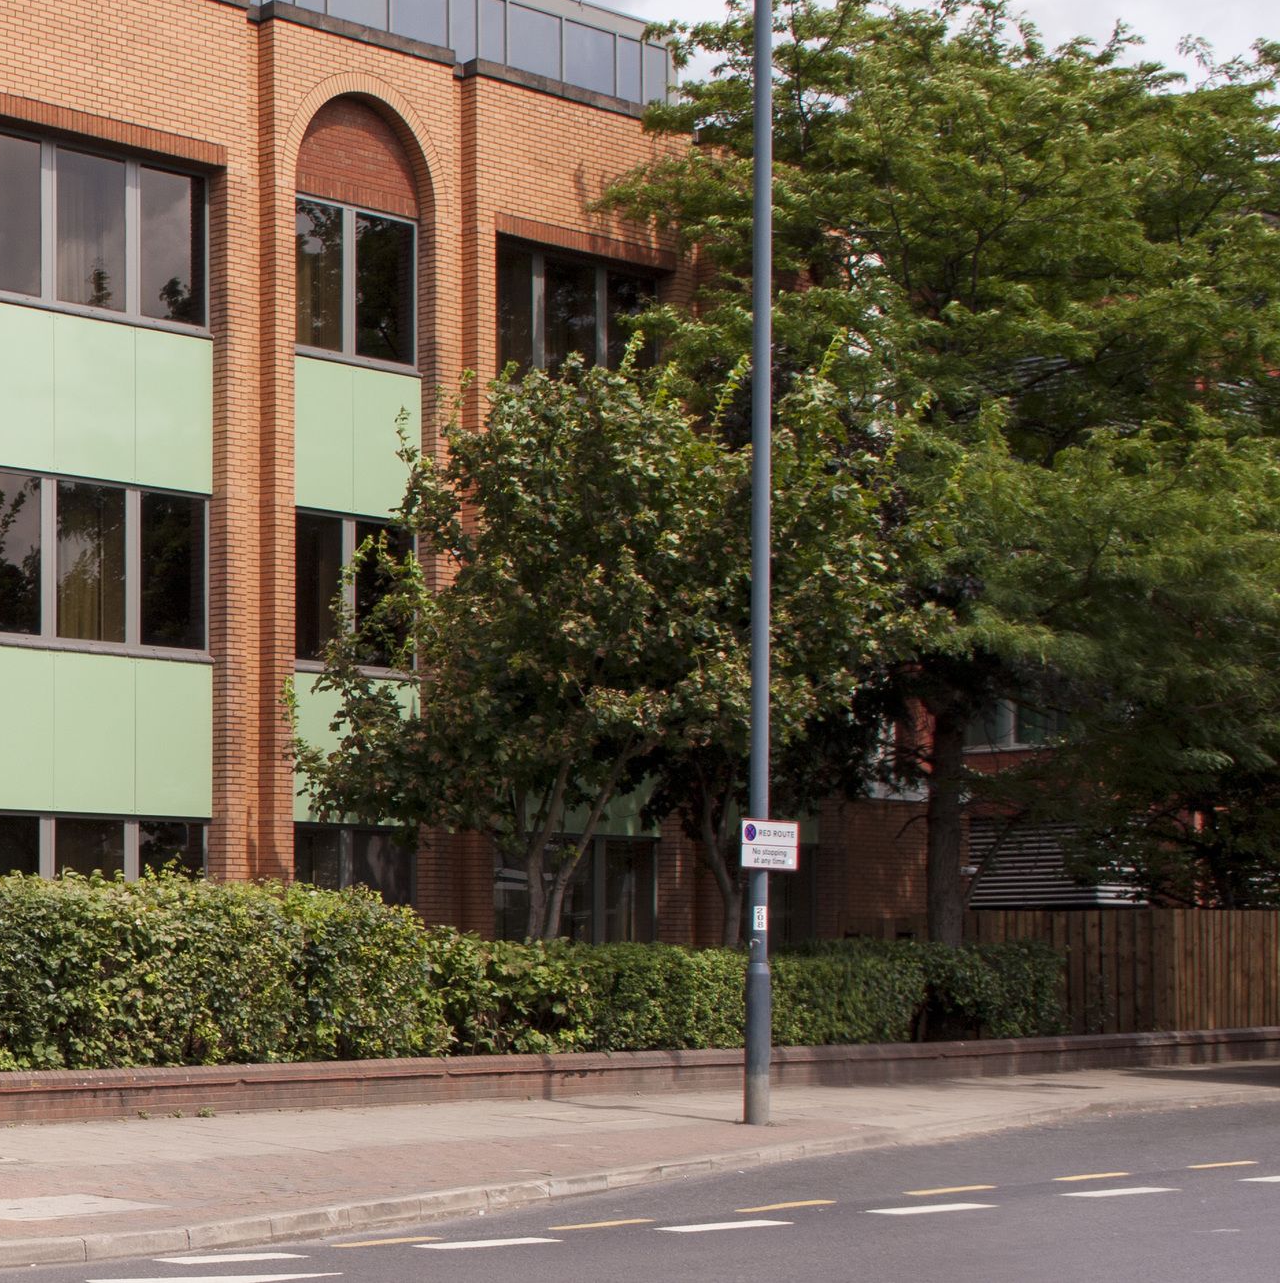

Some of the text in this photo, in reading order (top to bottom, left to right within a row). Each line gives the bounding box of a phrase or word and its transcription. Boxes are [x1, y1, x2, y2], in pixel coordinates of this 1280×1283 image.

[758, 829, 794, 838] RED ROUTE
[762, 849, 787, 857] stopping
